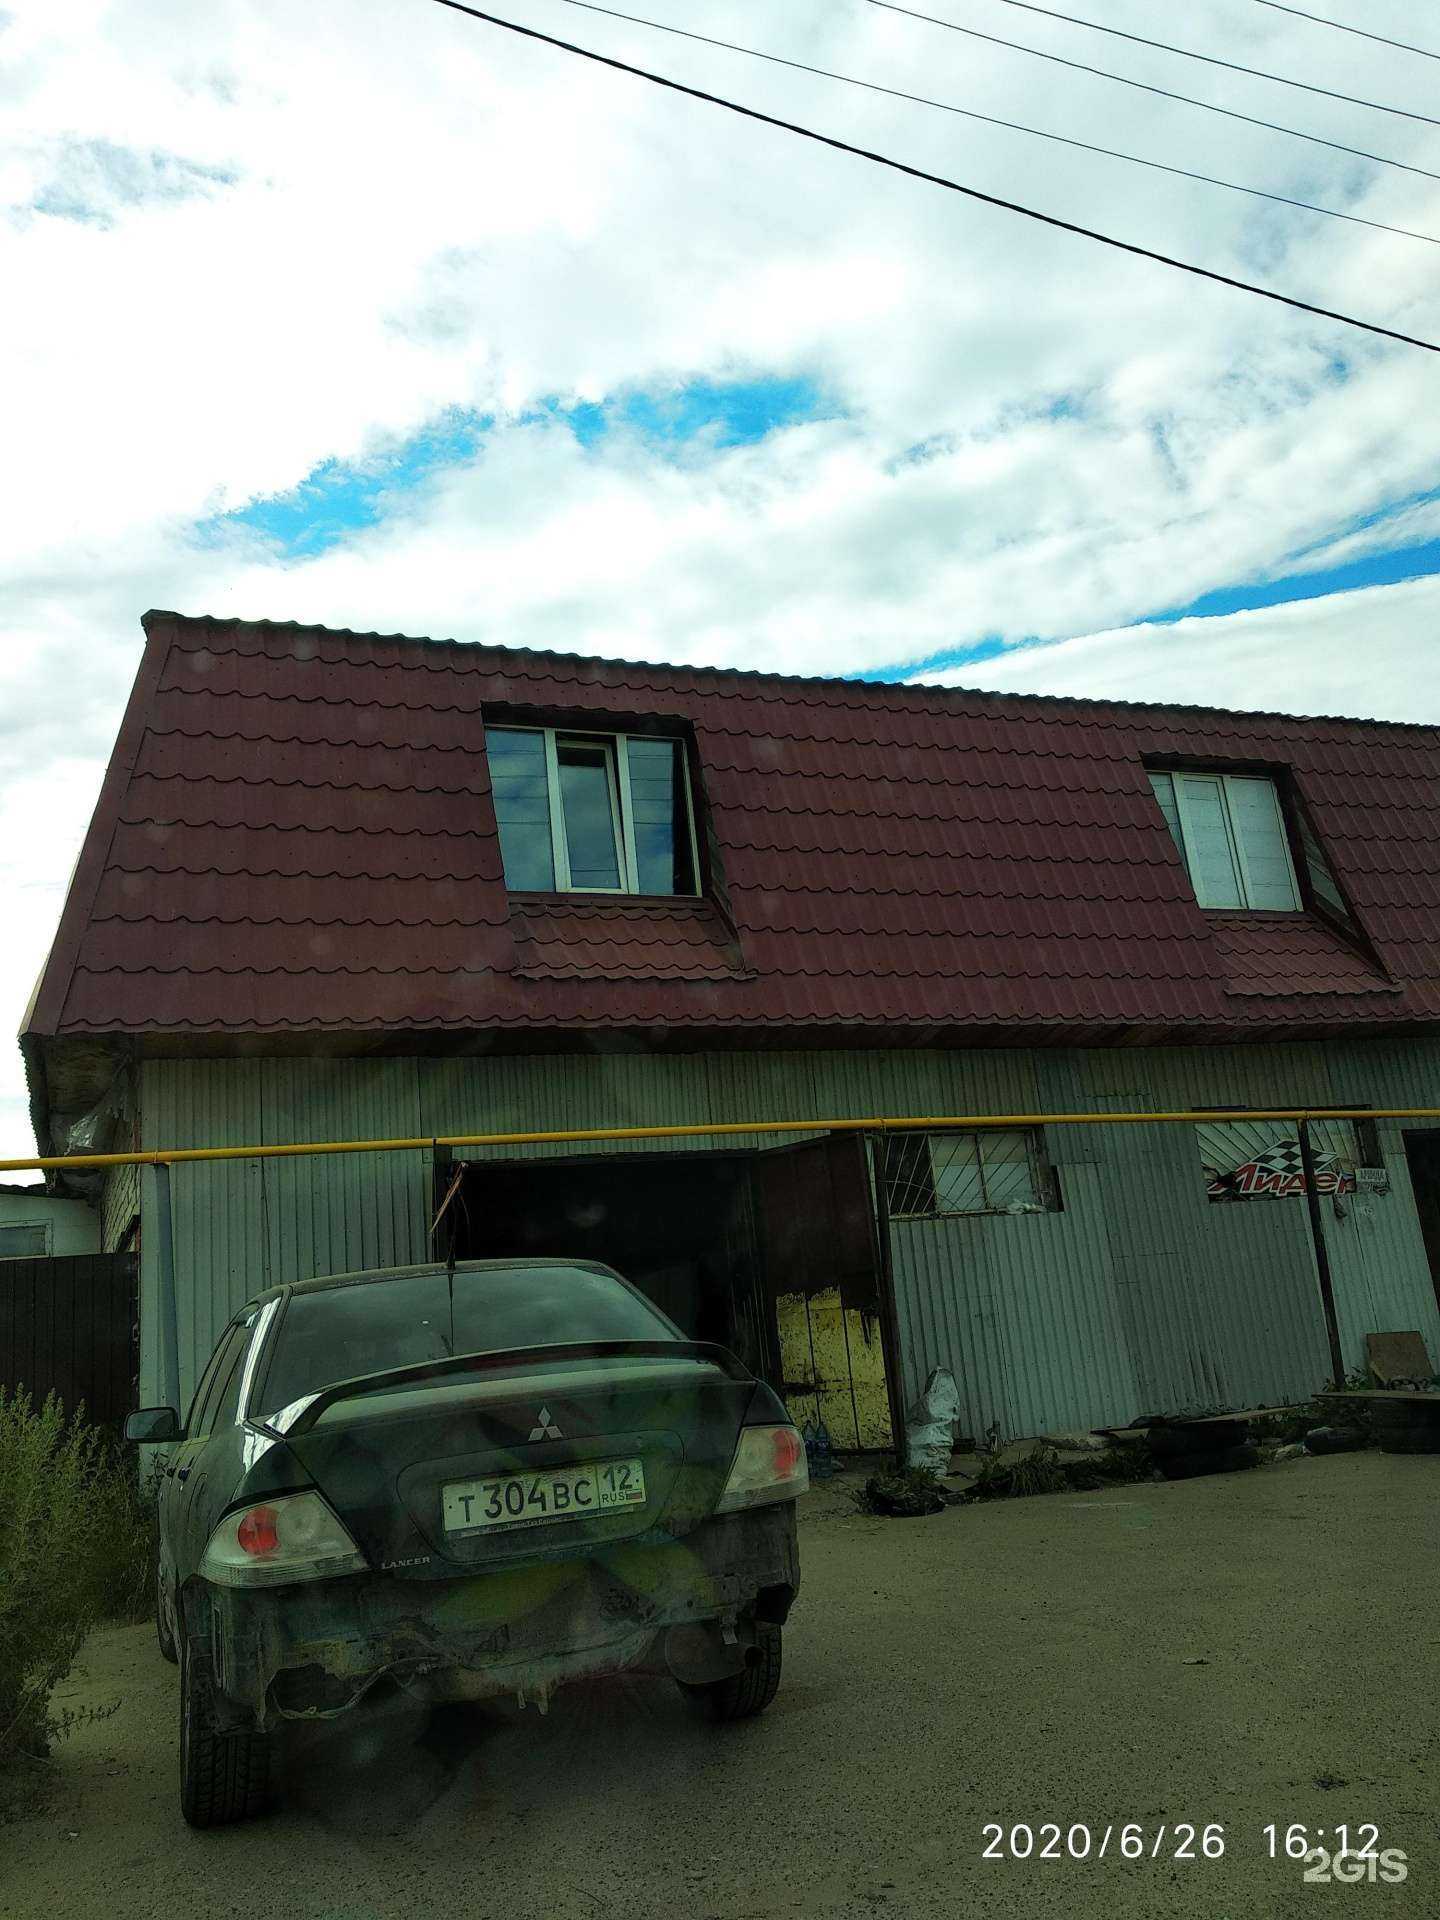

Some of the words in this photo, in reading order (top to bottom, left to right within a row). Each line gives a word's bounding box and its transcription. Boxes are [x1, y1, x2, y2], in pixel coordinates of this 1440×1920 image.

[602, 1464, 633, 1491] 12
[601, 1490, 625, 1503] RUS
[381, 1556, 431, 1570] LANCER
